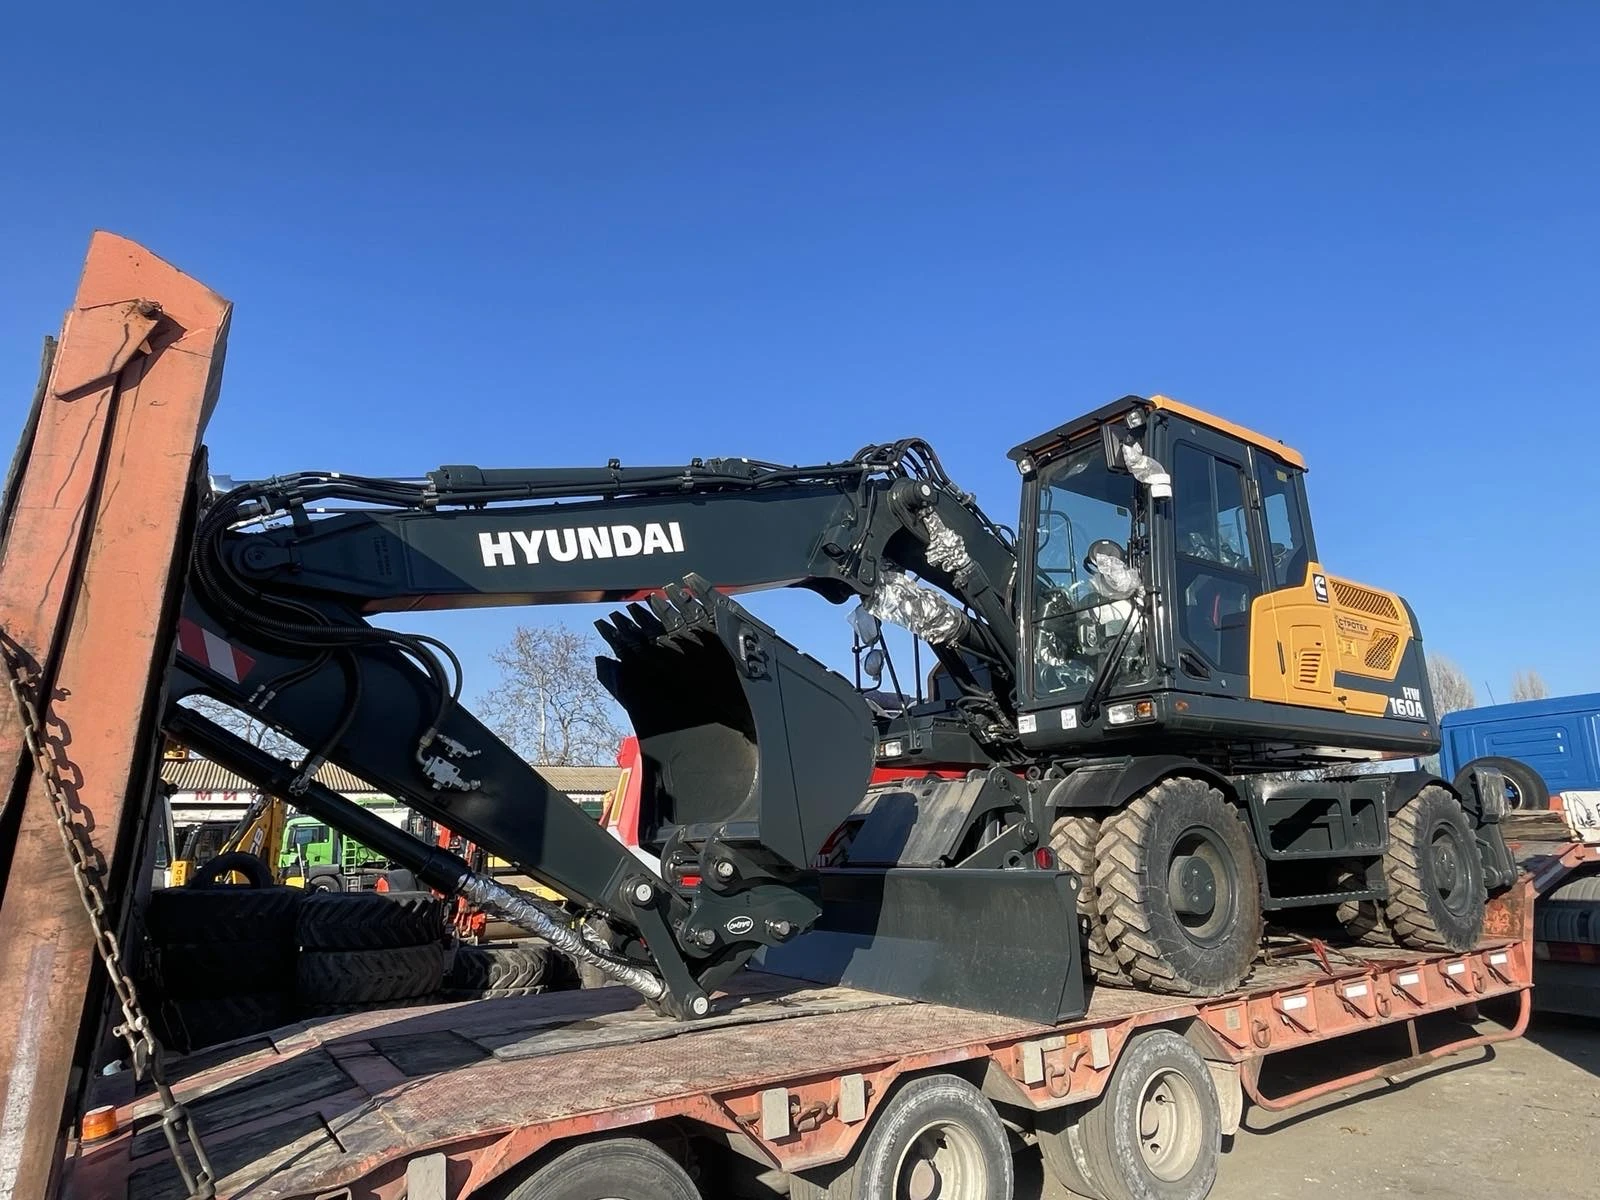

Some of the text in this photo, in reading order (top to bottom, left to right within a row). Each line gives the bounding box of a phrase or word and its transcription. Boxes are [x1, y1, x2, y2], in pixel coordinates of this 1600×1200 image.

[478, 521, 685, 567] HYUNDAI
[1403, 687, 1420, 701] HW
[1389, 697, 1425, 718] 160A
